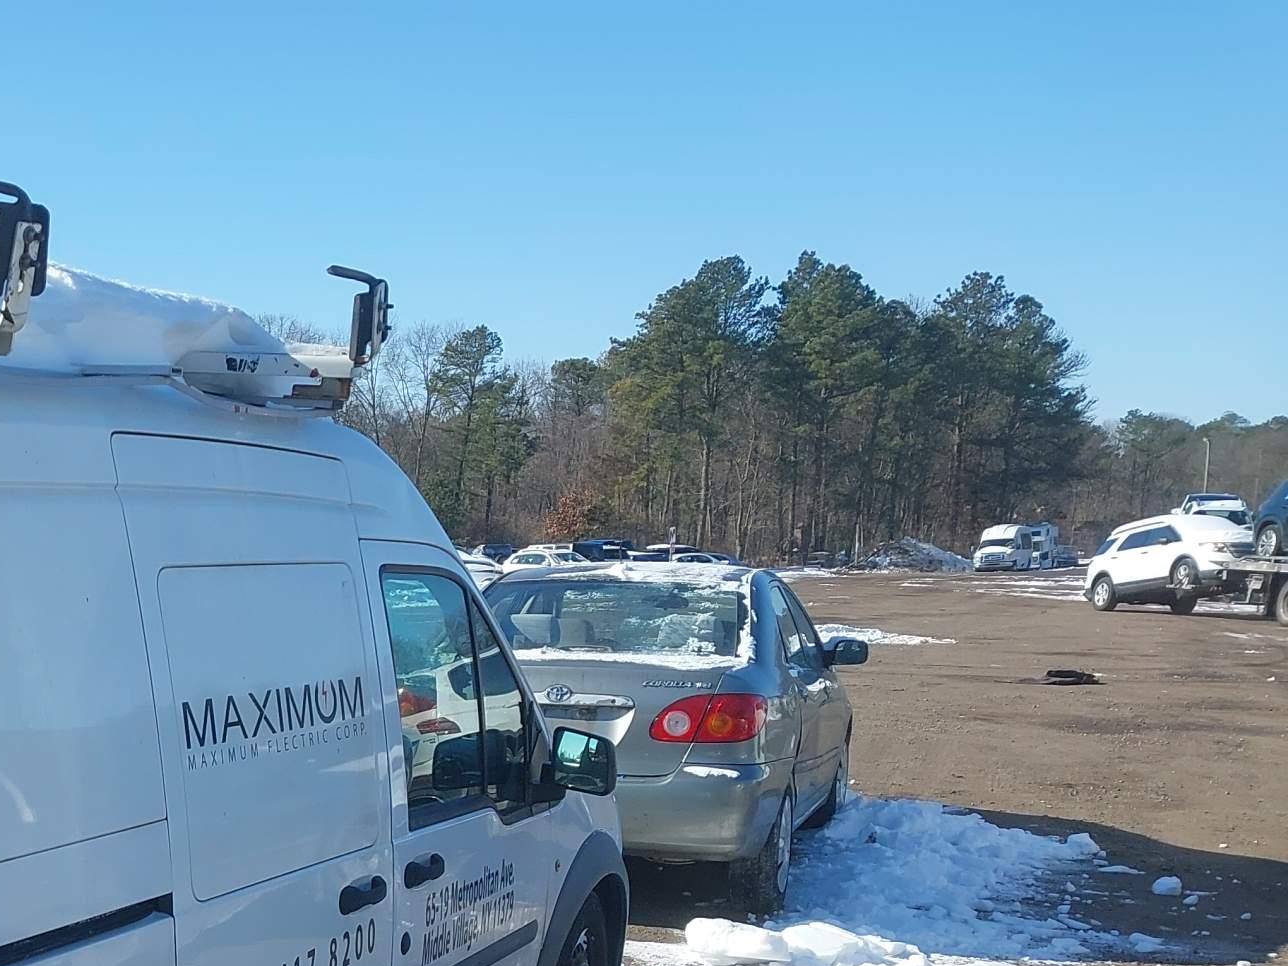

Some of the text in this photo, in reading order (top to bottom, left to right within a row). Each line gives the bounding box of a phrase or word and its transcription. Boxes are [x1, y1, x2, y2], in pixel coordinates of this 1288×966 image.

[181, 677, 365, 749] MAXIMUM
[187, 743, 259, 771] MAXIMUM
[335, 721, 368, 742] CORP.
[425, 858, 515, 928] 65-19 Metropolitan Ave.
[480, 901, 492, 935] NY
[493, 889, 515, 929] 11379
